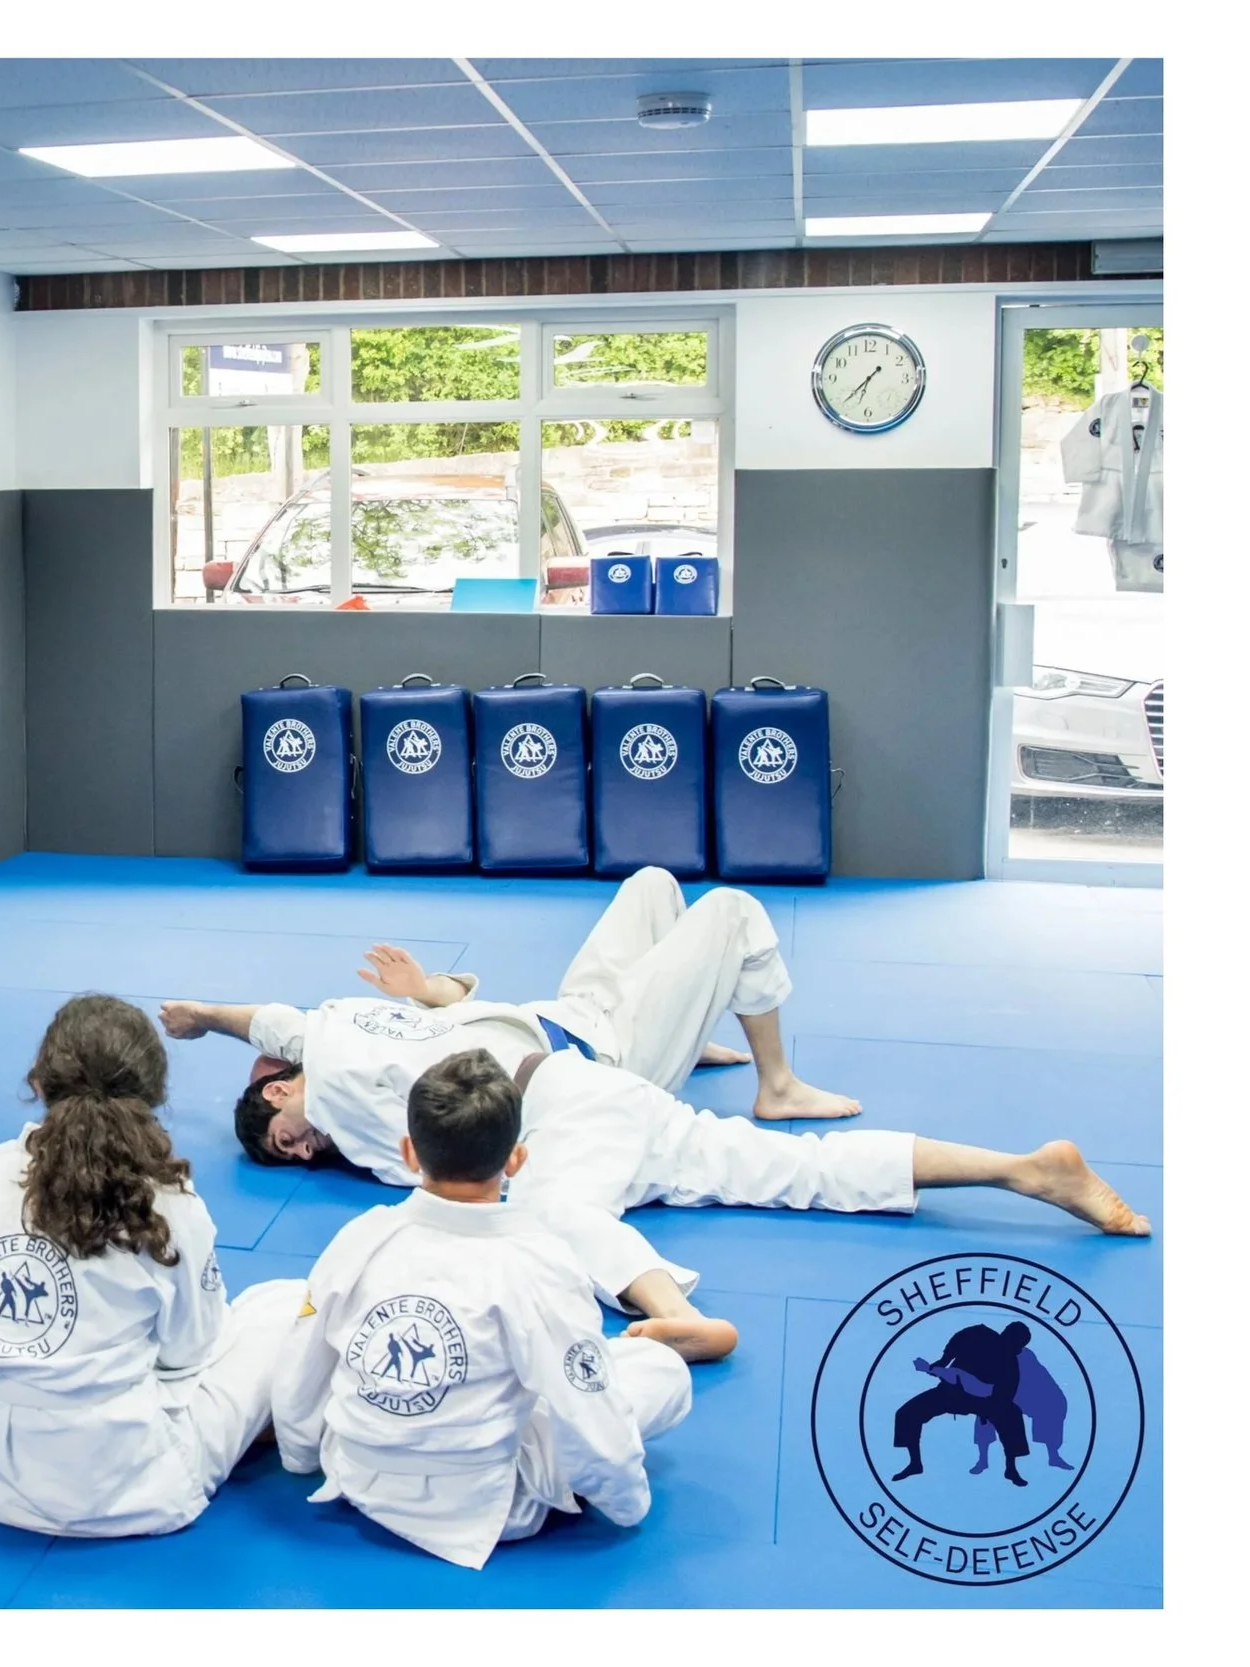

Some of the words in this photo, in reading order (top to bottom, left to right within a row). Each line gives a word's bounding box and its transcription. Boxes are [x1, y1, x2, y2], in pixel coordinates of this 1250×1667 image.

[848, 344, 858, 357] 11
[863, 339, 877, 353] 12
[835, 357, 847, 369] 10
[895, 355, 904, 367] 2
[828, 374, 837, 384] 9
[901, 372, 909, 384] 3
[863, 407, 872, 418] 6
[264, 721, 284, 752] VALENTE
[388, 721, 409, 752] VALENTE
[502, 725, 524, 756] VALENTE
[621, 726, 644, 757] VALENTE
[740, 730, 762, 761] VALENTE
[273, 758, 307, 771] JUJUTSU
[397, 759, 432, 772] JUJUTSU
[511, 764, 547, 777] JUJUTSU
[630, 765, 667, 778] JUJUTSU
[748, 769, 787, 782] JUJUTSU
[350, 1300, 409, 1361] VALENTE
